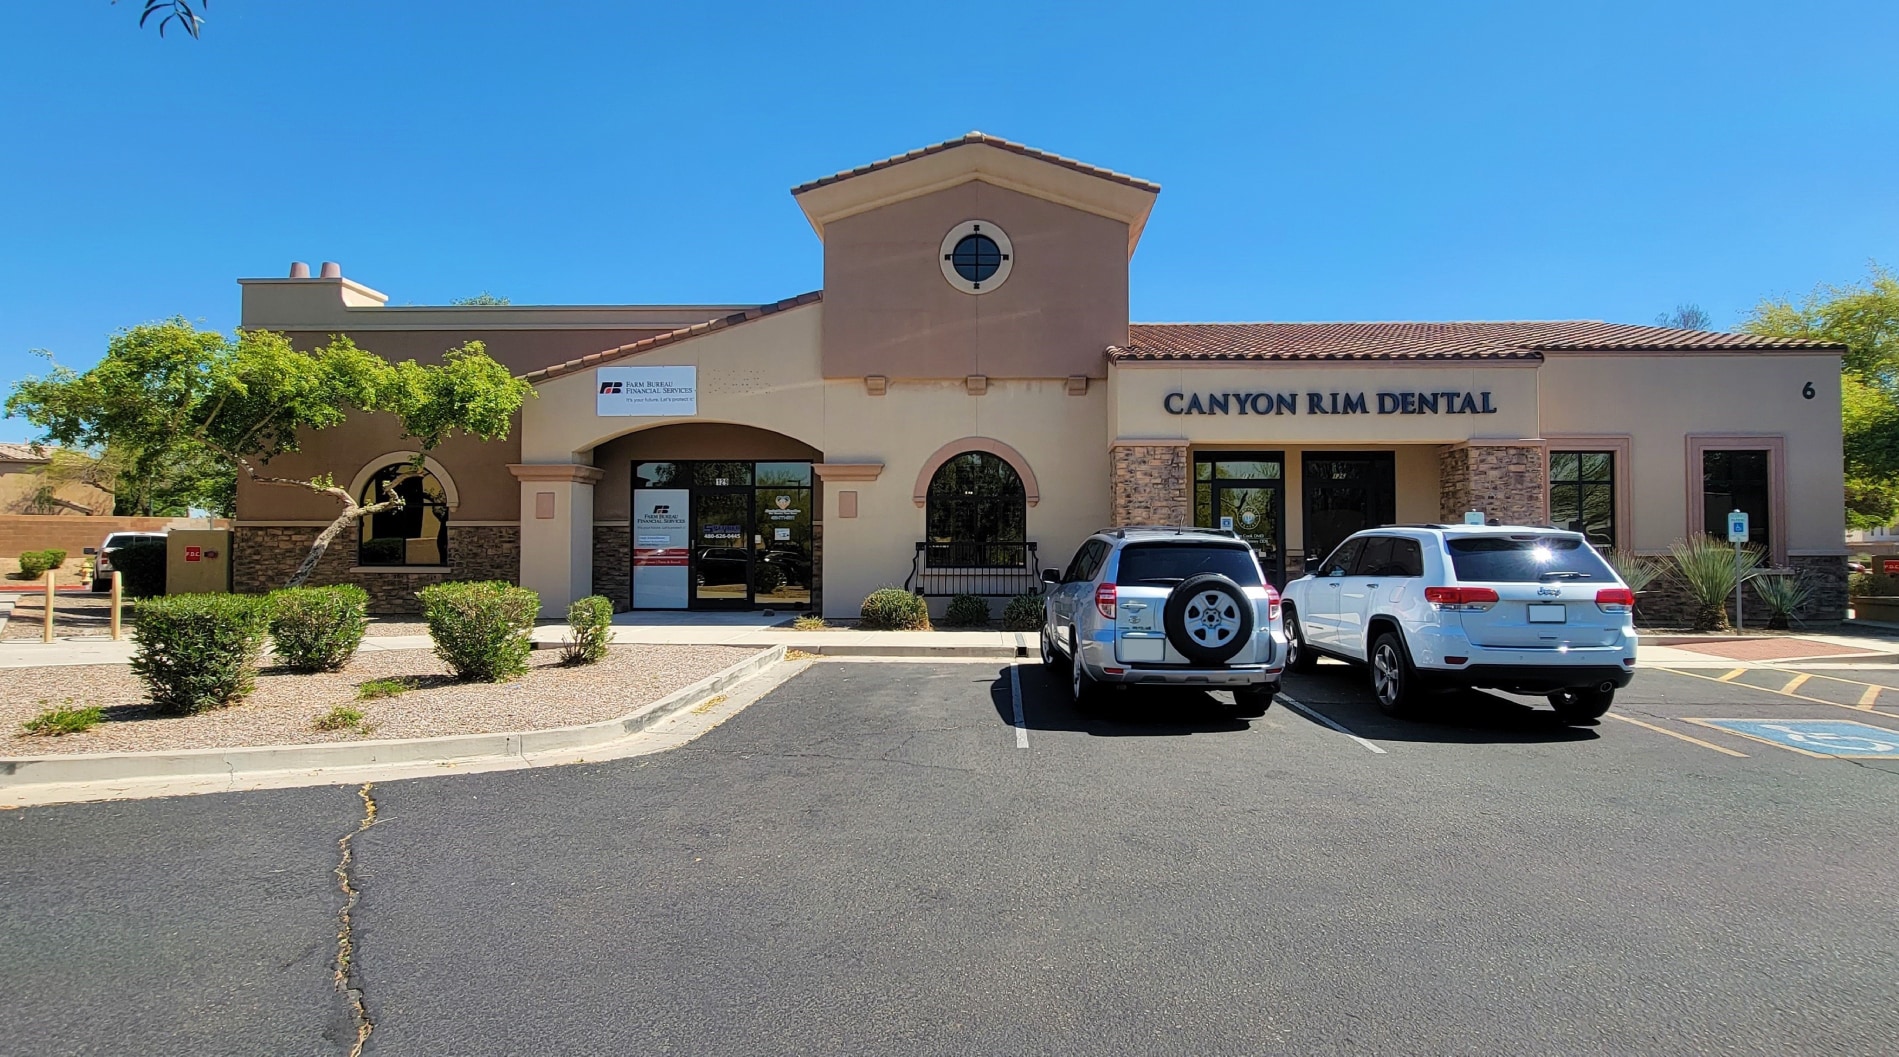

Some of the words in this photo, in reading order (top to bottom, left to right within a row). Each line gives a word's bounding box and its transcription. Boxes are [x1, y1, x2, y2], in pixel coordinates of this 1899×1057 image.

[1802, 381, 1815, 400] 6
[1163, 392, 1298, 415] CANYON
[1306, 391, 1370, 415] RIM
[1376, 391, 1498, 415] DENTAL
[1537, 586, 1562, 598] Jeep
